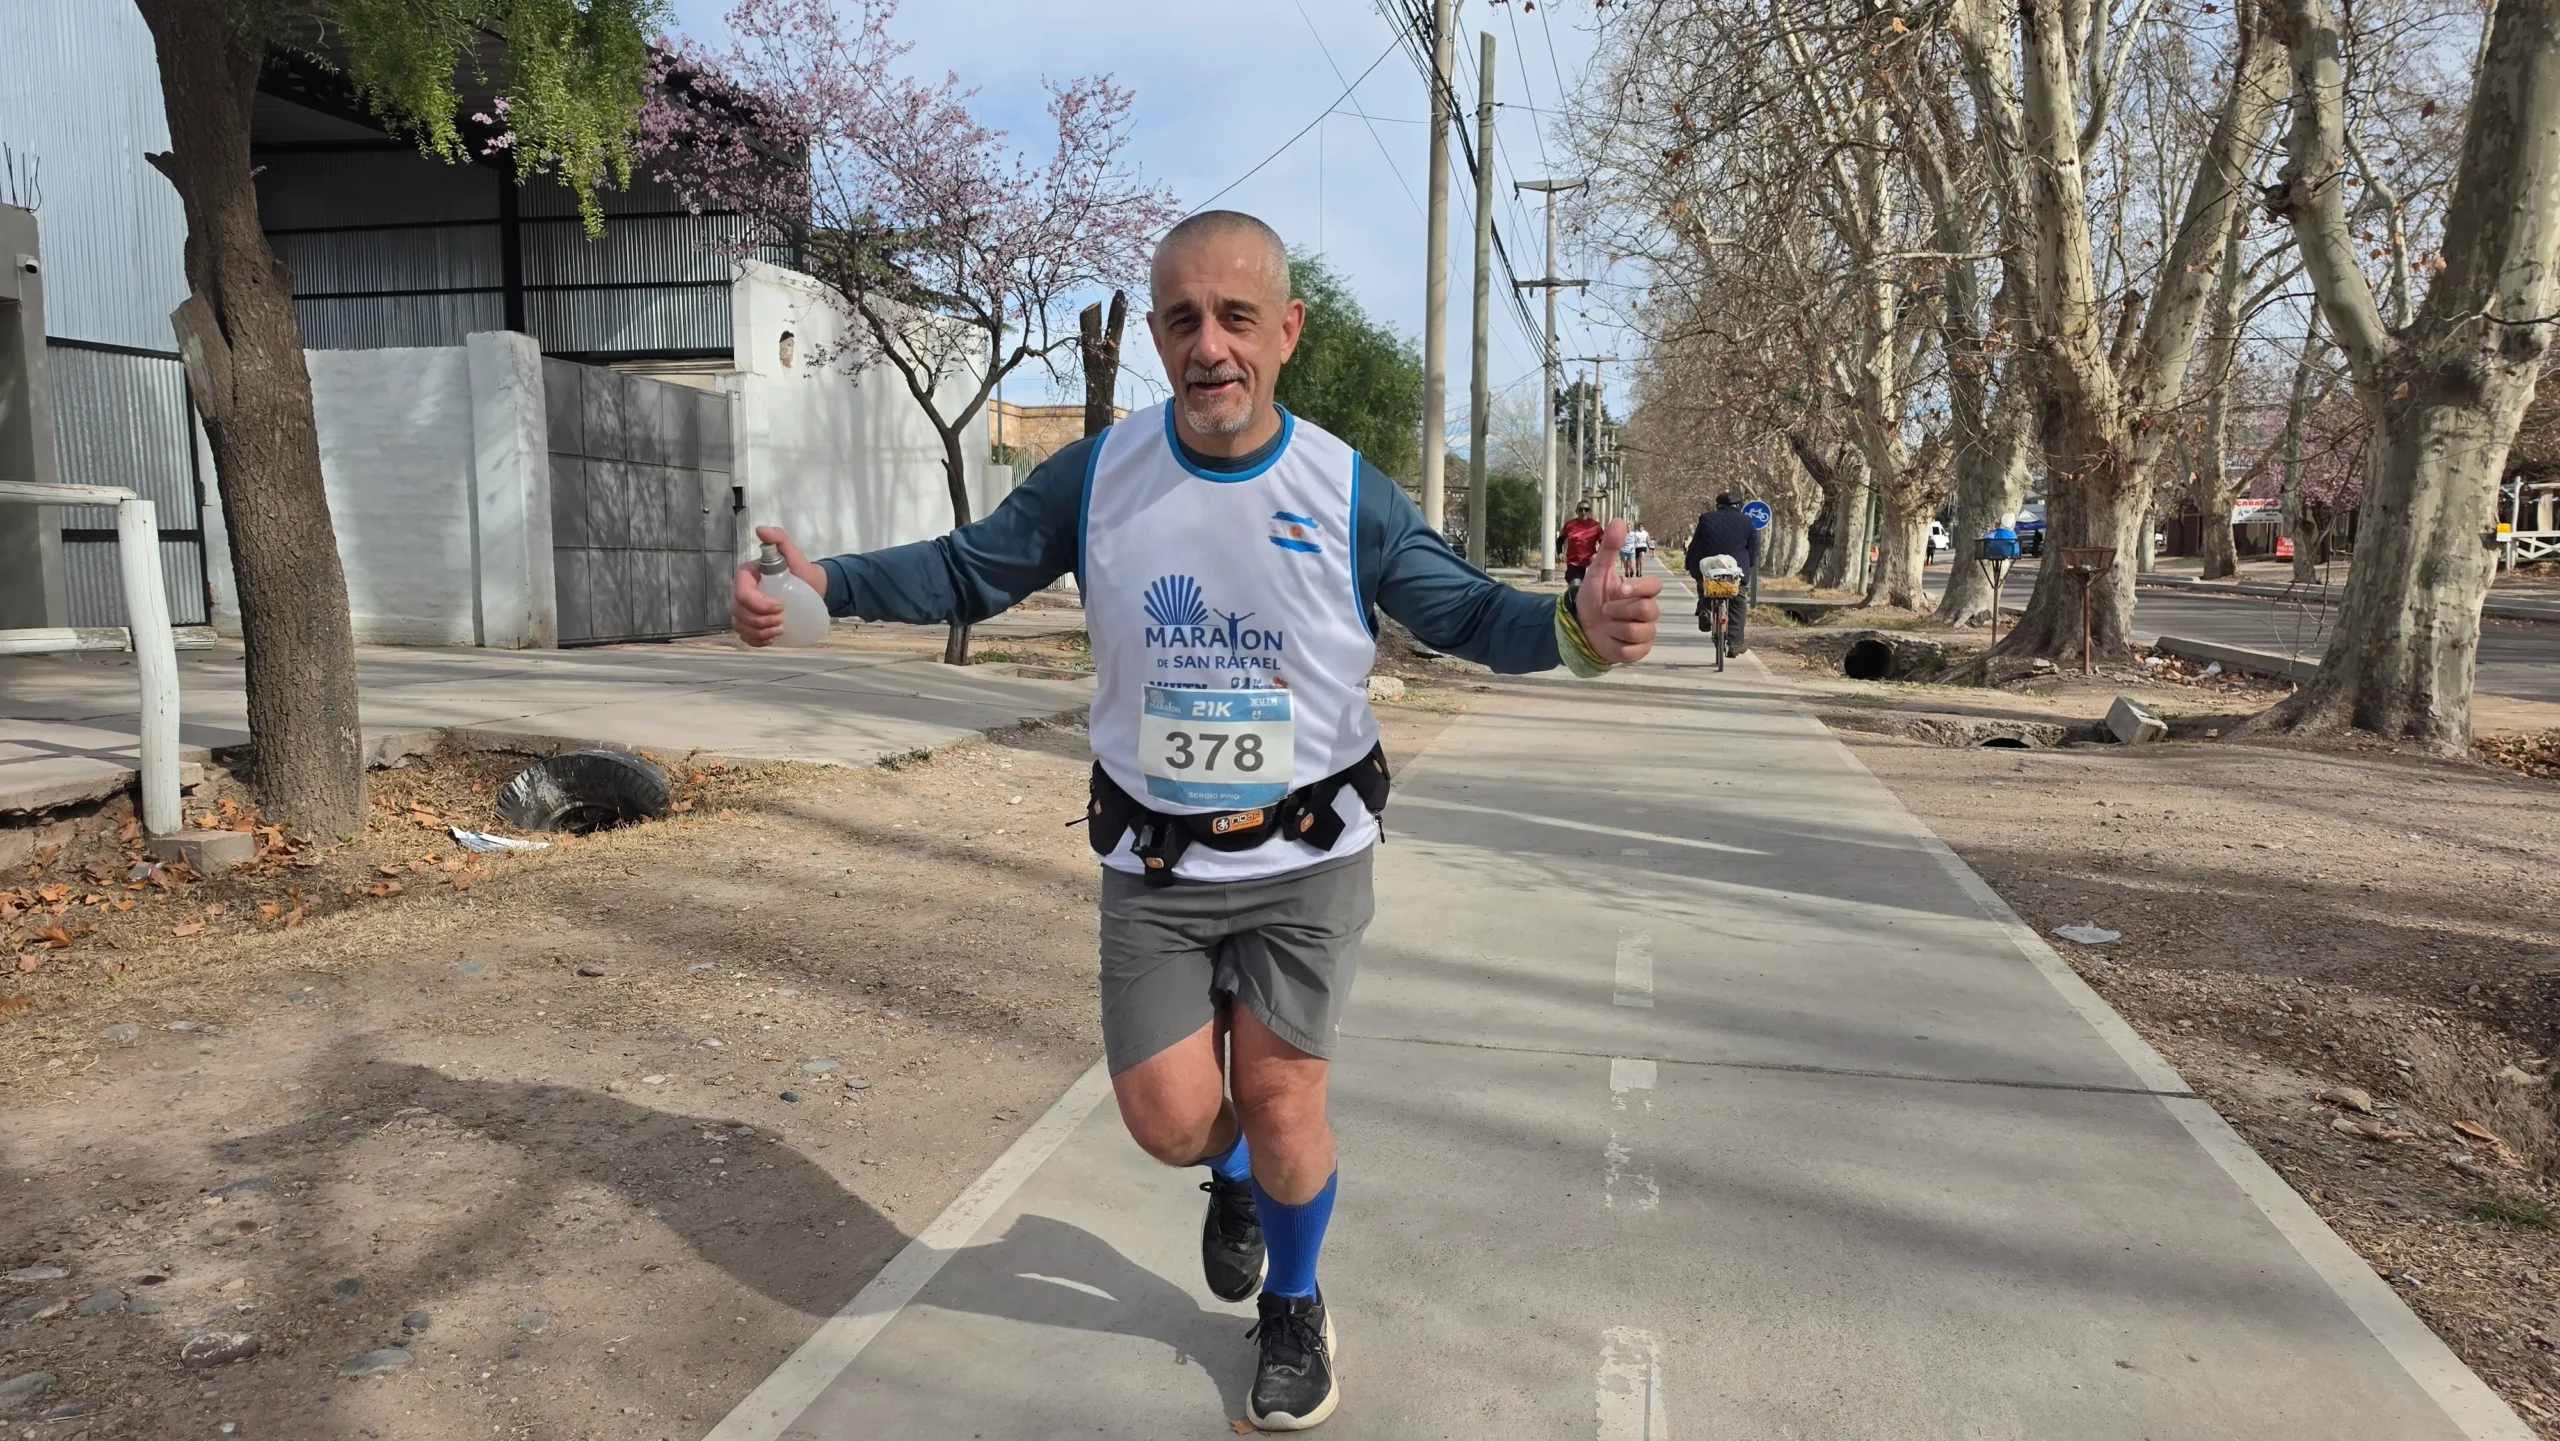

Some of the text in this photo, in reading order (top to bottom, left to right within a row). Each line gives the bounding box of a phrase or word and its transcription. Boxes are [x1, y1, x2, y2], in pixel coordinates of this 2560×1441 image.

[1145, 622, 1283, 652] MARATON
[1157, 655, 1281, 670] DE SAN RAFAEL
[1192, 701, 1234, 717] 21K
[1165, 731, 1264, 772] 378
